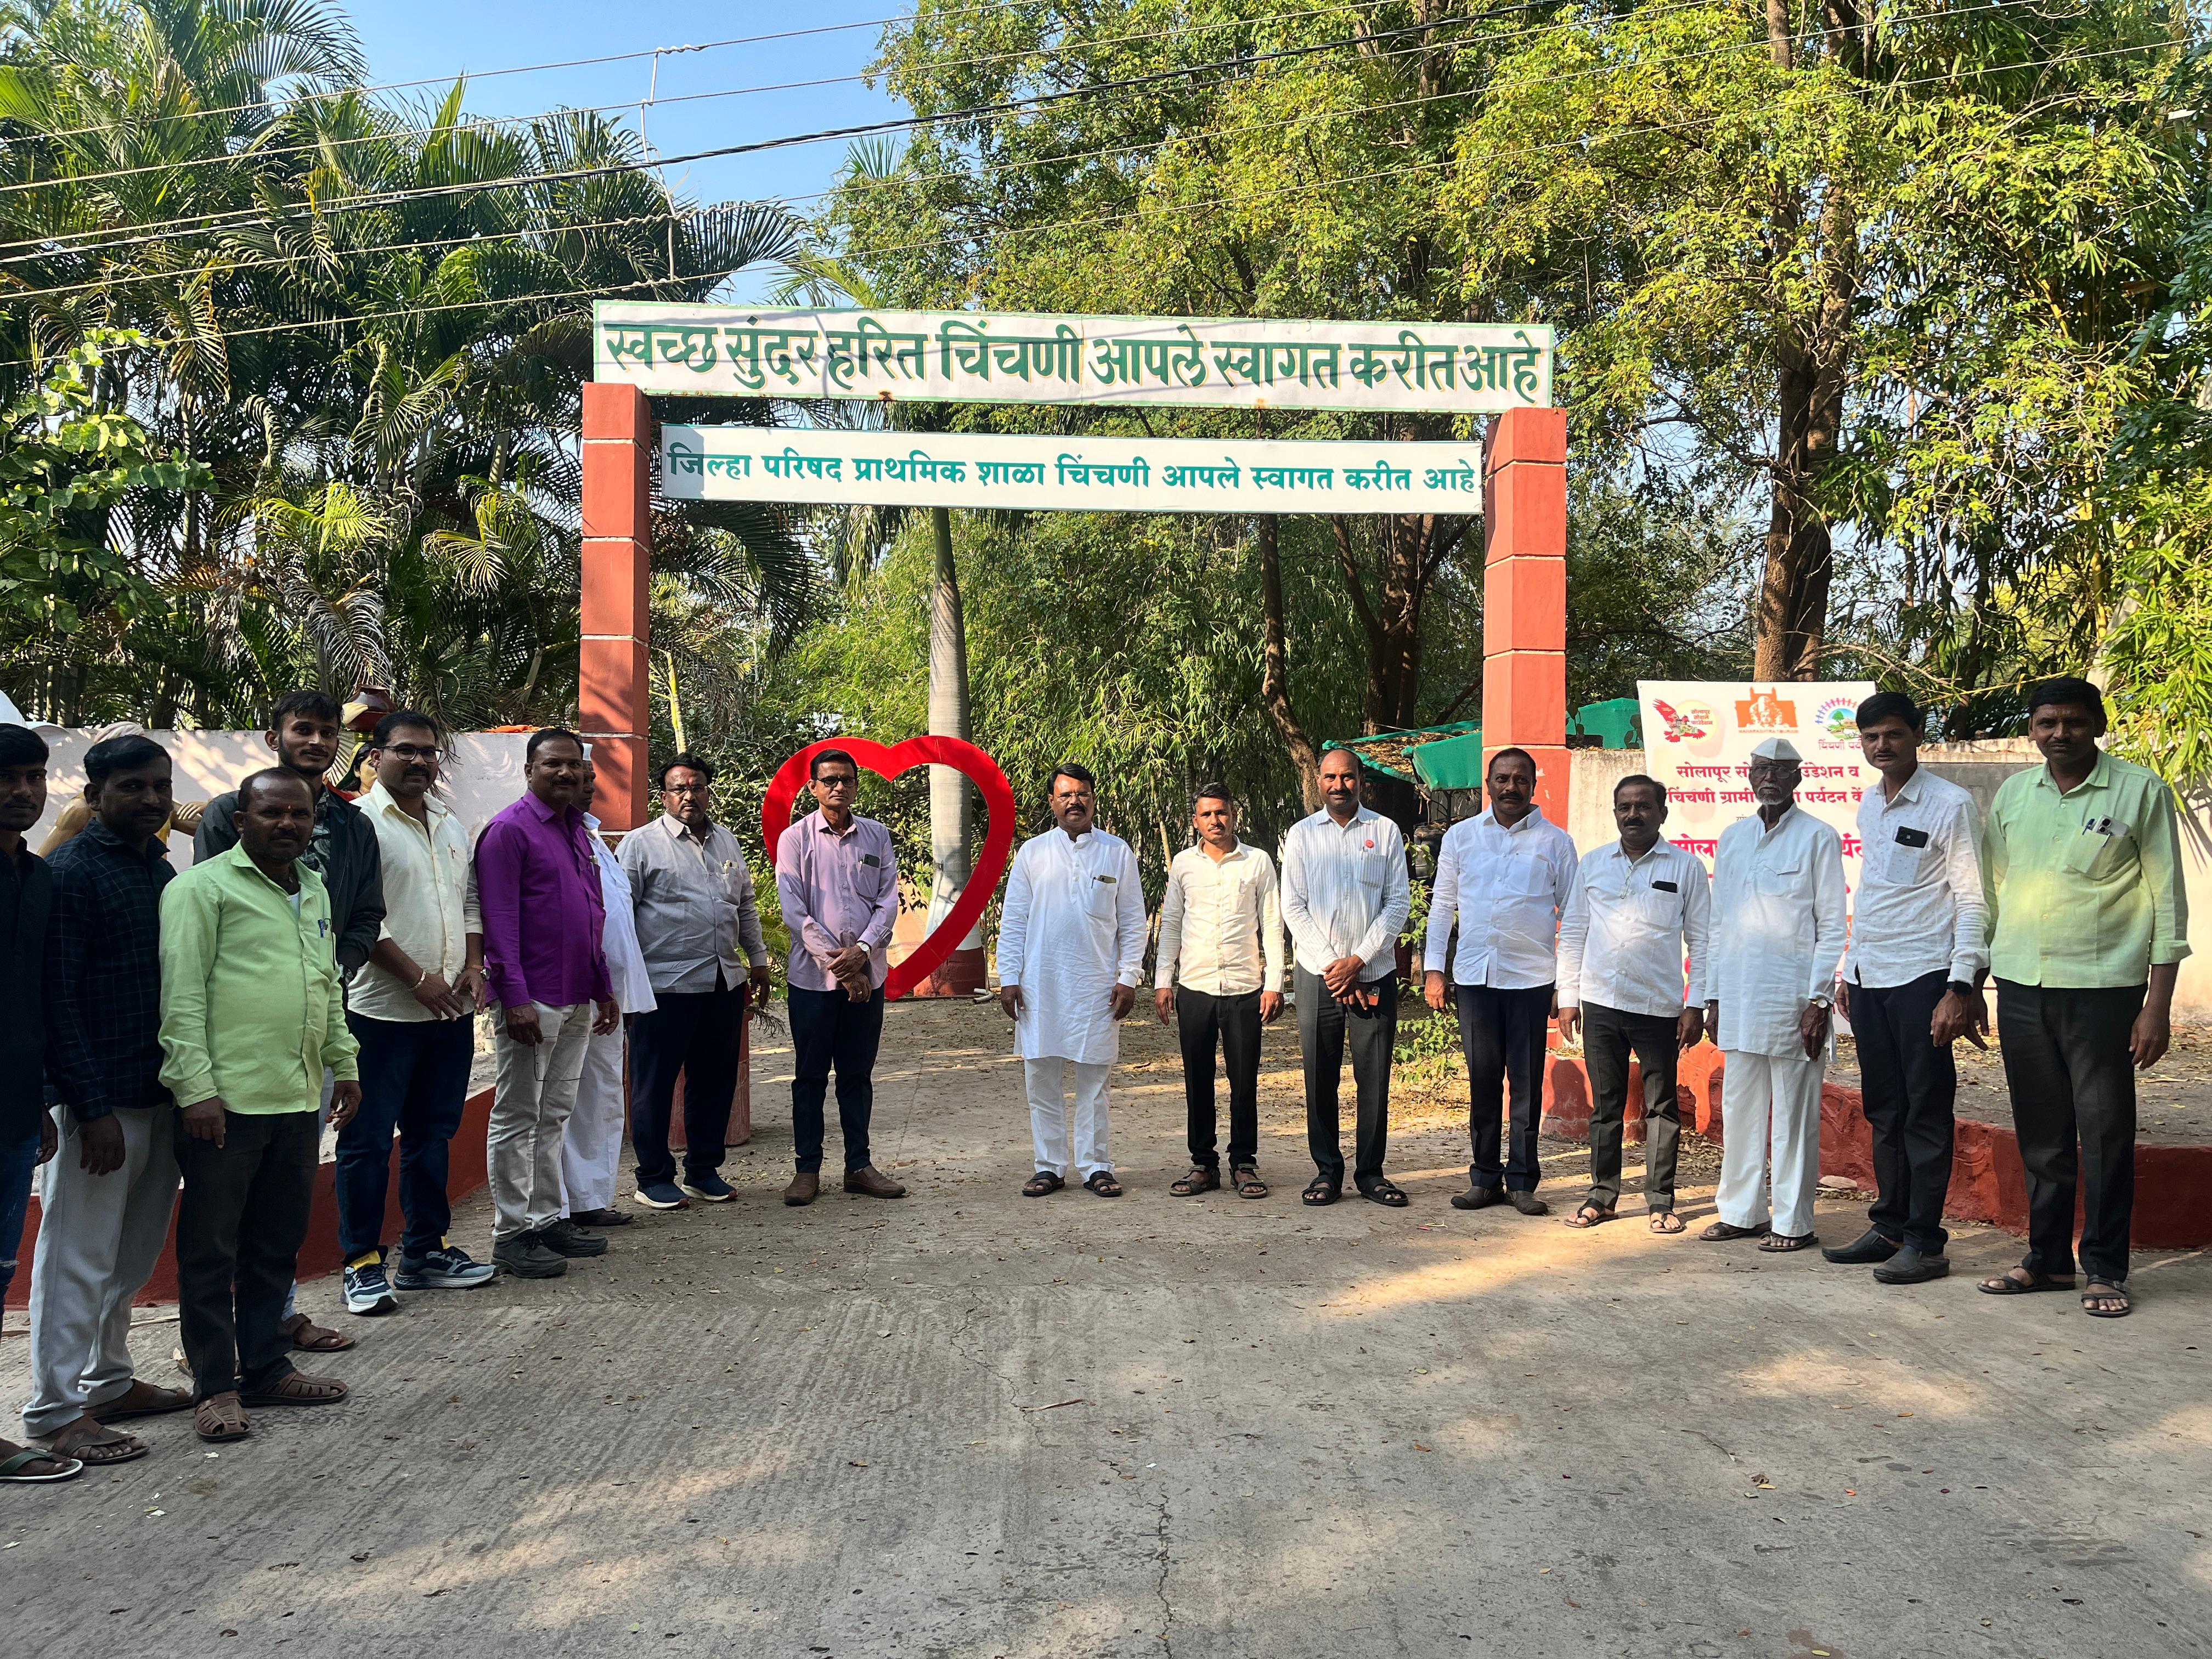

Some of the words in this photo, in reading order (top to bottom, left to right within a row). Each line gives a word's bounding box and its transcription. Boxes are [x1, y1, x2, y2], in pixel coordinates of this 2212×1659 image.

[603, 323, 719, 373] स्वच्छ
[724, 315, 820, 390] सुंदर
[826, 316, 930, 391] हरित
[935, 319, 1082, 385] चिंचणी
[1088, 323, 1206, 388] आपले
[1210, 340, 1342, 391] स्वागत
[1347, 330, 1459, 393] करीत
[1459, 330, 1541, 405] आहे
[665, 442, 752, 478] जिल्हा
[761, 447, 843, 483] परिषद
[852, 450, 966, 484] प्राथमिक
[976, 461, 1046, 487] शाळा
[1054, 453, 1150, 488] चिंचणी
[1161, 456, 1241, 489] आपले
[1251, 467, 1334, 490] स्वागत
[1343, 460, 1412, 491] करीत
[1423, 459, 1474, 494] आहे
[1676, 761, 1731, 783] सोलापूर
[1847, 766, 1859, 777] व
[1667, 786, 1716, 803] चिंचणी
[1719, 787, 1758, 804] ग्रामी
[1805, 786, 1847, 803] पर्यटन
